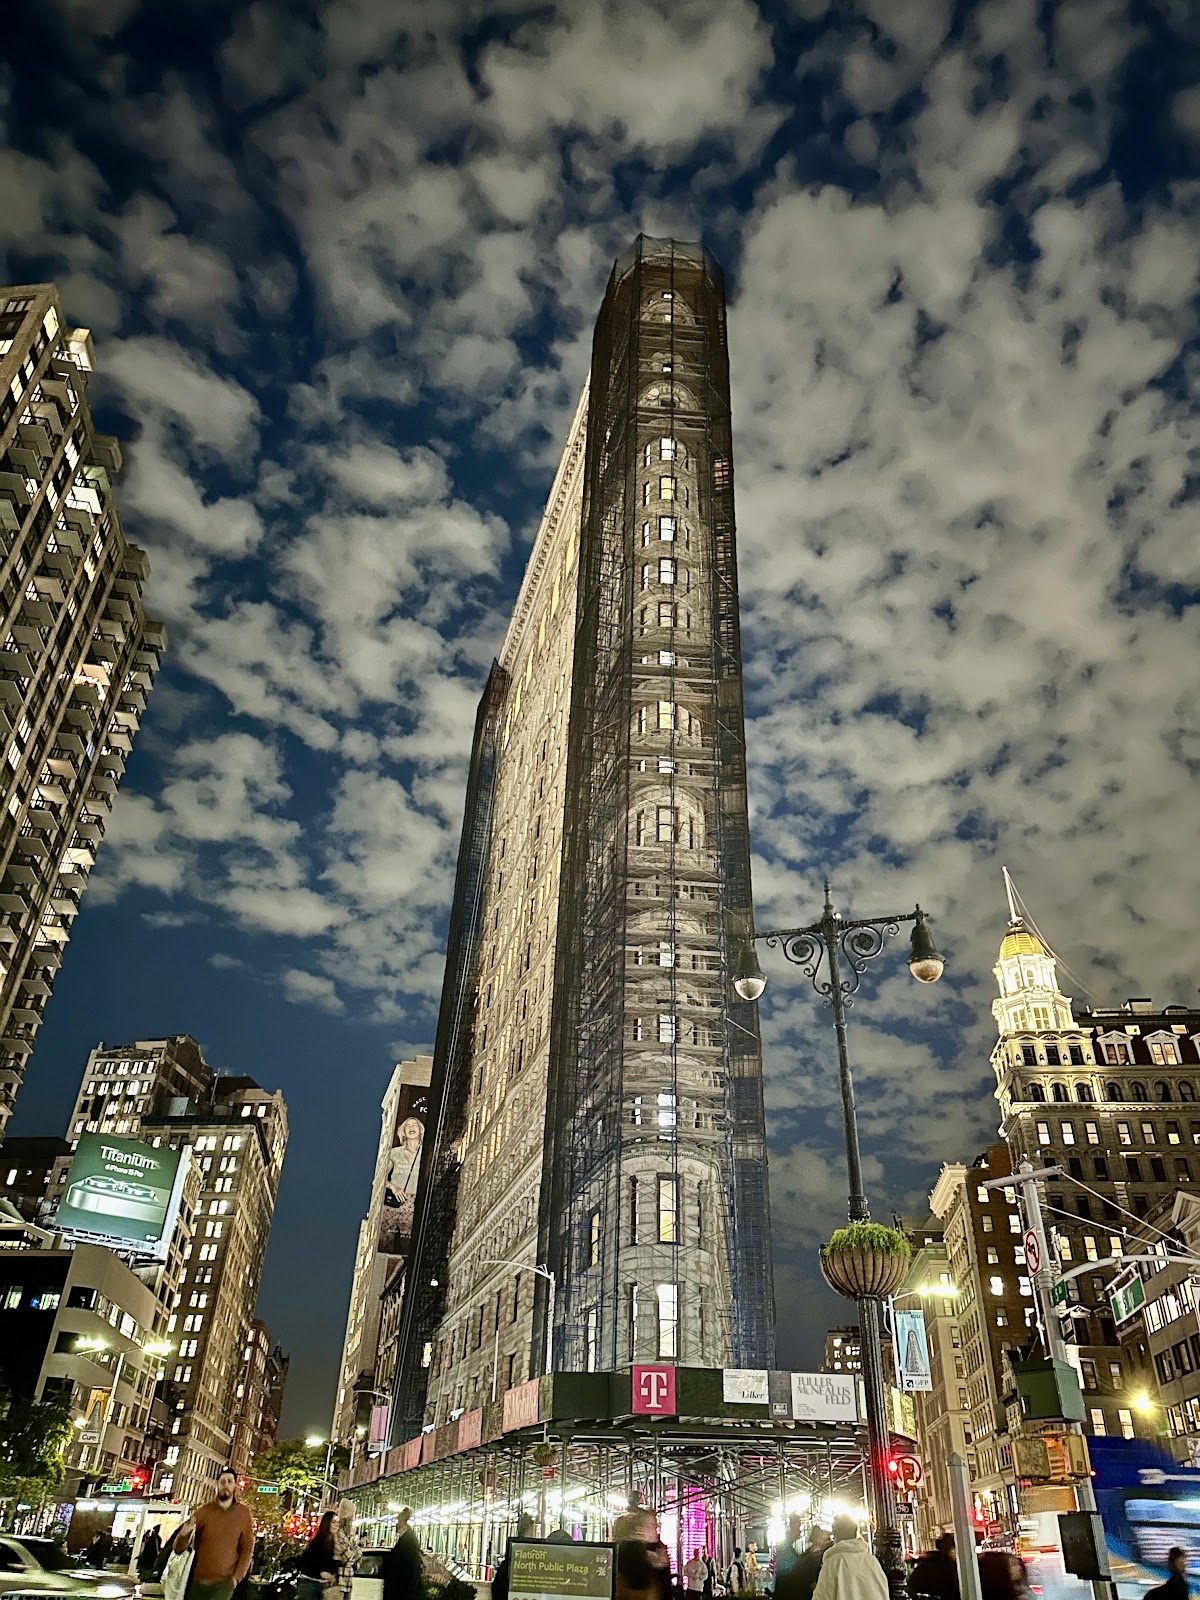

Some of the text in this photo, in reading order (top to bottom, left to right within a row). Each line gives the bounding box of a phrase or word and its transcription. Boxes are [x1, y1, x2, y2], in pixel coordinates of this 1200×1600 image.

[101, 1145, 157, 1170] Titanium
[797, 1377, 833, 1387] TULLER
[641, 1371, 667, 1408] T
[742, 1390, 764, 1399] Lilker
[825, 1395, 850, 1405] FELD
[82, 1433, 97, 1441] Cure
[514, 1549, 546, 1560] Flatiron
[514, 1560, 589, 1575] North Public Plaza
